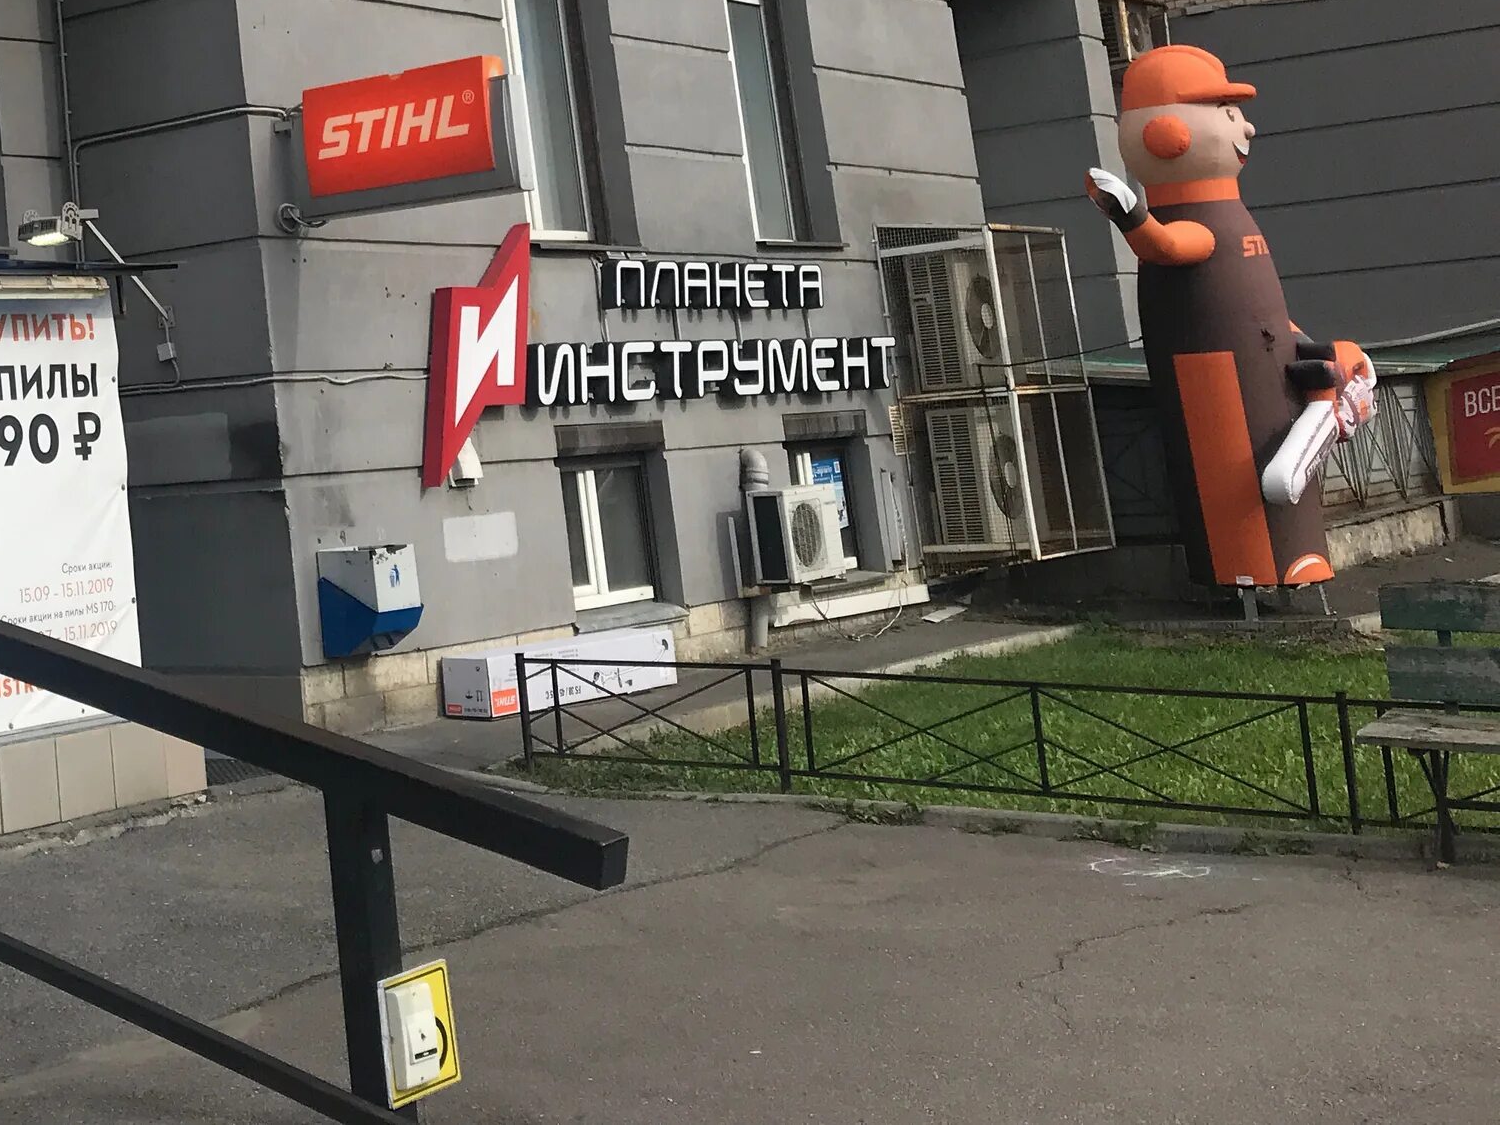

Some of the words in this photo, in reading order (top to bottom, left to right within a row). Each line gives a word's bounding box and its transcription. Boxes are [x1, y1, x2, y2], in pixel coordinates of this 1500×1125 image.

[318, 94, 471, 161] STIHL
[612, 259, 825, 309] ПЛАНЕТА
[535, 336, 897, 406] ИНСТРУМЕНТ
[61, 562, 87, 575] Сроки
[88, 561, 113, 572] акции:
[19, 585, 50, 604] 15.09
[61, 577, 114, 598] 15.11.2019
[28, 612, 52, 623] акции
[53, 610, 63, 619] на
[64, 608, 85, 618] пилы
[86, 603, 99, 615] MS
[64, 620, 118, 642] 15.11.2019
